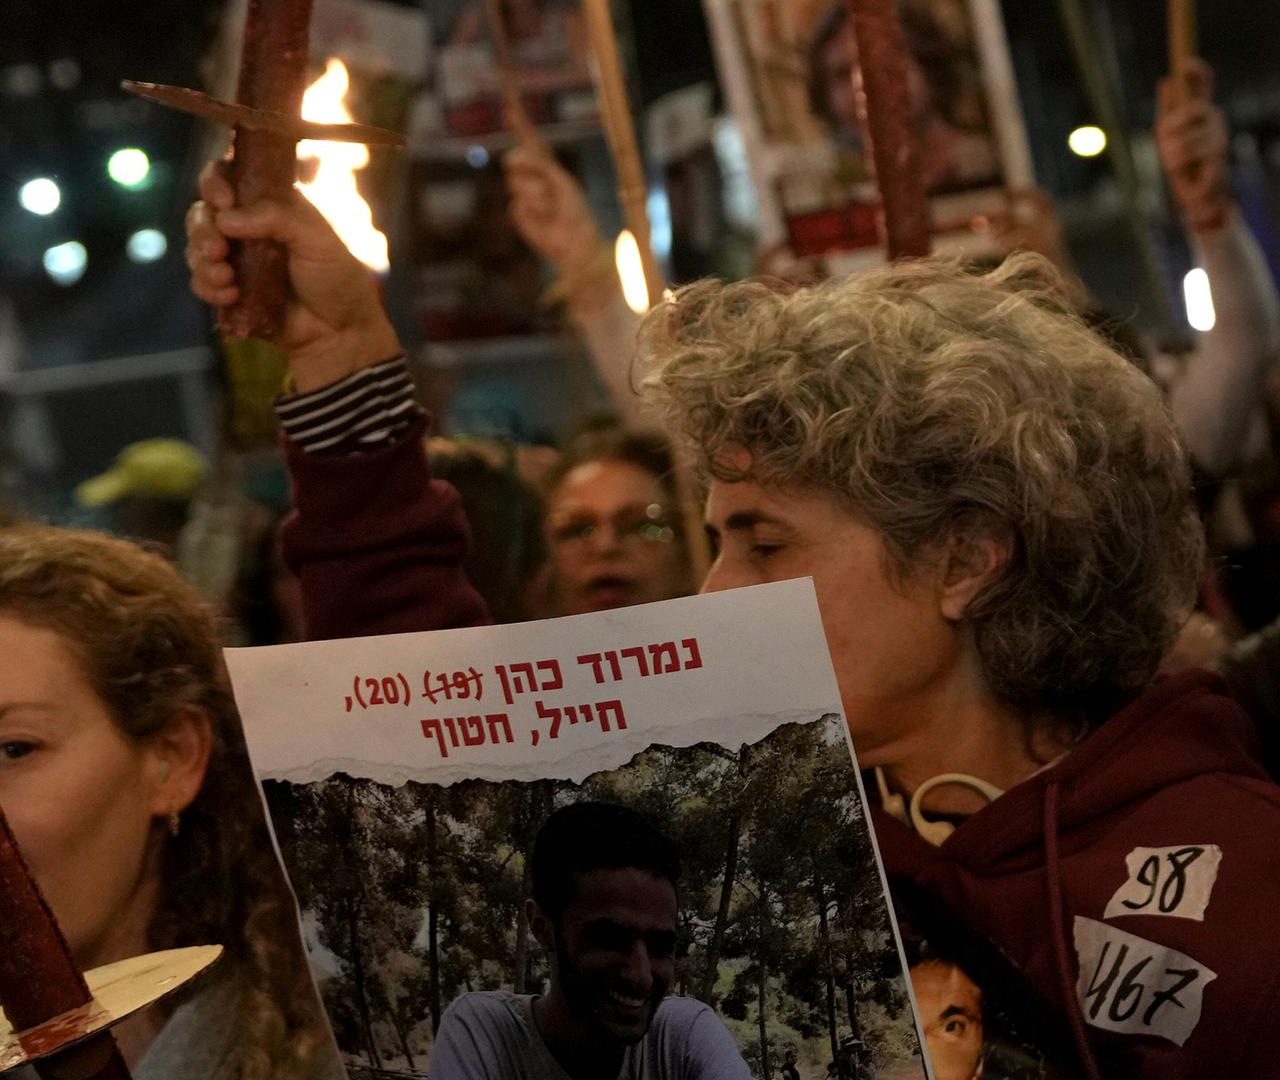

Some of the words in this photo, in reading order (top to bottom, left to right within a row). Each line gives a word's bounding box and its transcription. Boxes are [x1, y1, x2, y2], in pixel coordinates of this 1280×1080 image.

[494, 658, 564, 705] כהן
[576, 637, 703, 684] נמרוד
[420, 713, 515, 758] חטוף
[530, 699, 628, 747] חייל,
[1121, 846, 1206, 913] 98
[1085, 941, 1200, 1027] 467
